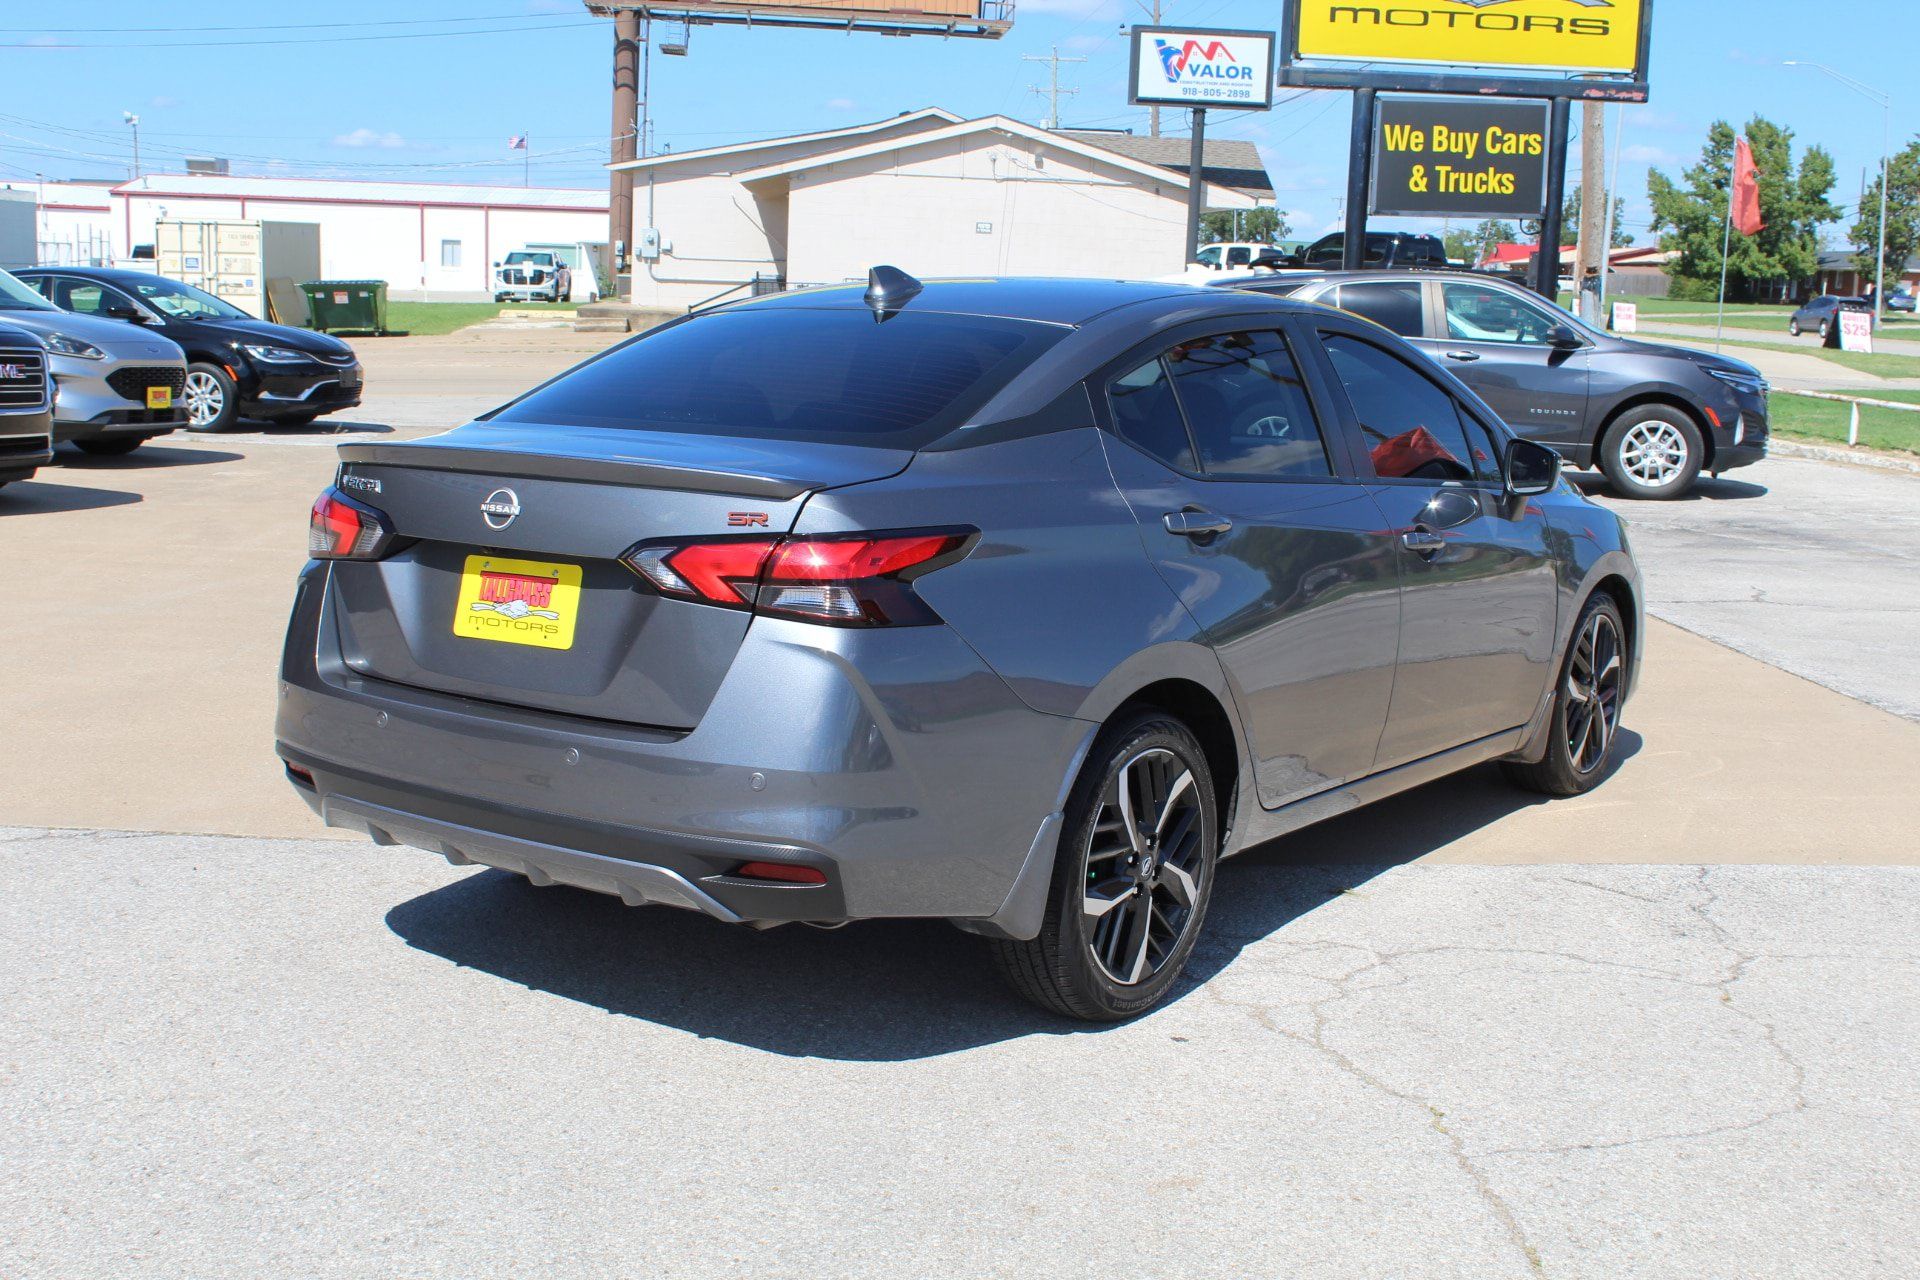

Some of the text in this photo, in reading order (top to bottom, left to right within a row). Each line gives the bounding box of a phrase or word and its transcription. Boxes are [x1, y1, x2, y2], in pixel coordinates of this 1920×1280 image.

[1329, 6, 1610, 36] MOTORS
[1188, 63, 1253, 80] VALOR
[1182, 87, 1250, 98] 918-805-2898
[1384, 124, 1542, 160] We Buy Cars
[1408, 164, 1516, 195] & Trucks
[1530, 408, 1577, 416] EQUINOX
[480, 503, 520, 516] NISSAN
[727, 511, 769, 527] SR
[479, 571, 559, 609] TALLGRASS
[468, 615, 559, 635] MOTORS
